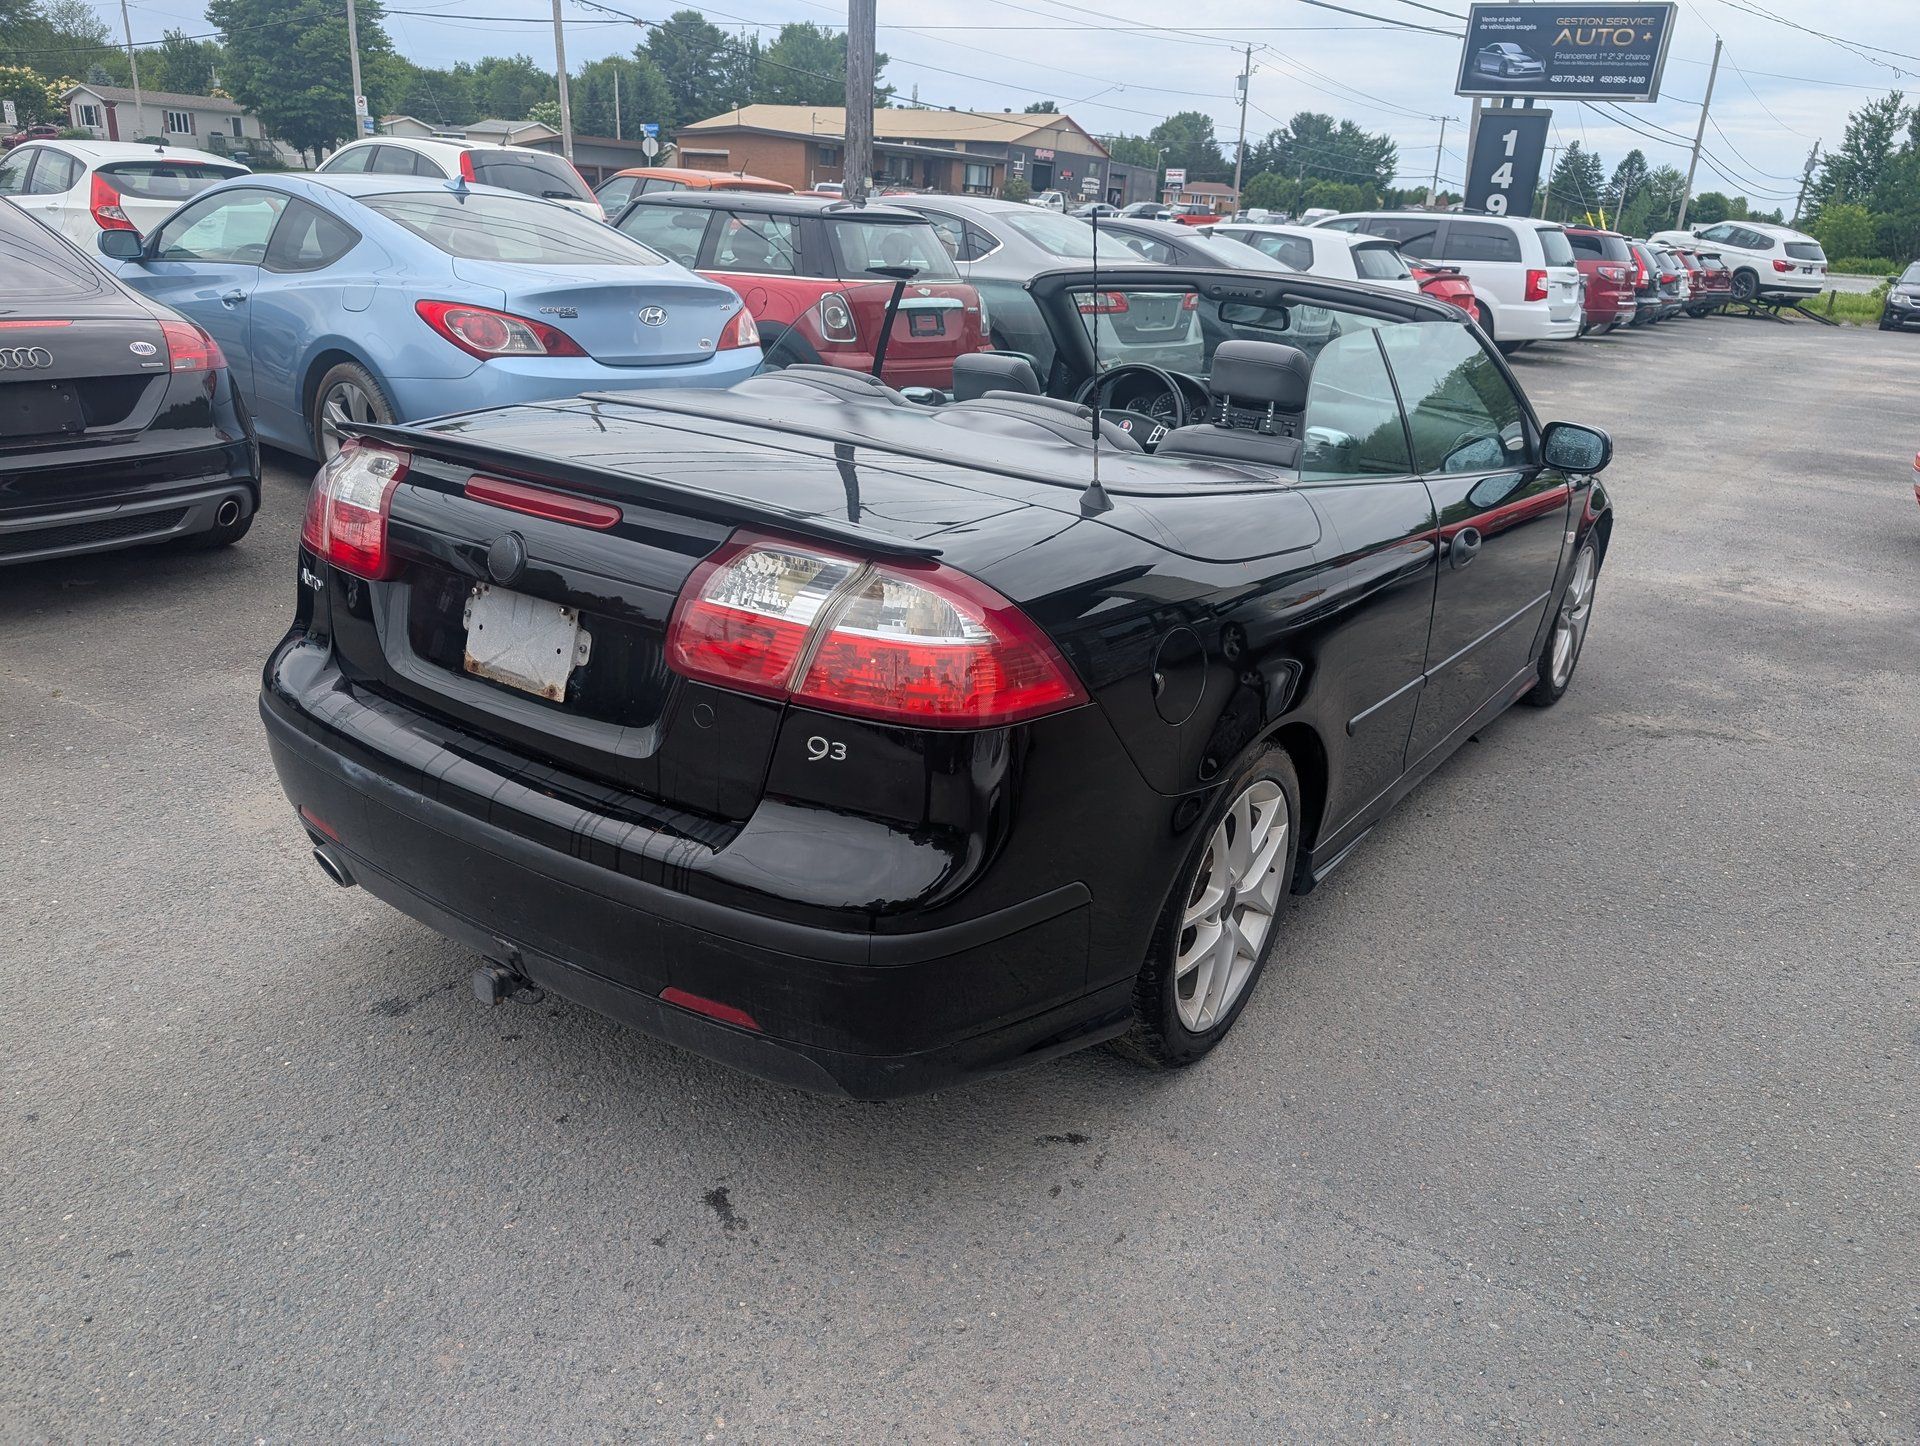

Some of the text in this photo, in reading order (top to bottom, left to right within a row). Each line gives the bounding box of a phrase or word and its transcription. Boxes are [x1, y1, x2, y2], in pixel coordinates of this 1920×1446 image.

[1556, 17, 1655, 26] GESTION SERVICE
[1552, 28, 1635, 47] AUTO
[1554, 52, 1598, 60] Financement
[1625, 53, 1651, 61] chance
[1549, 75, 1563, 83] 450
[1563, 75, 1595, 83] 770-2424
[1600, 75, 1613, 83] 450
